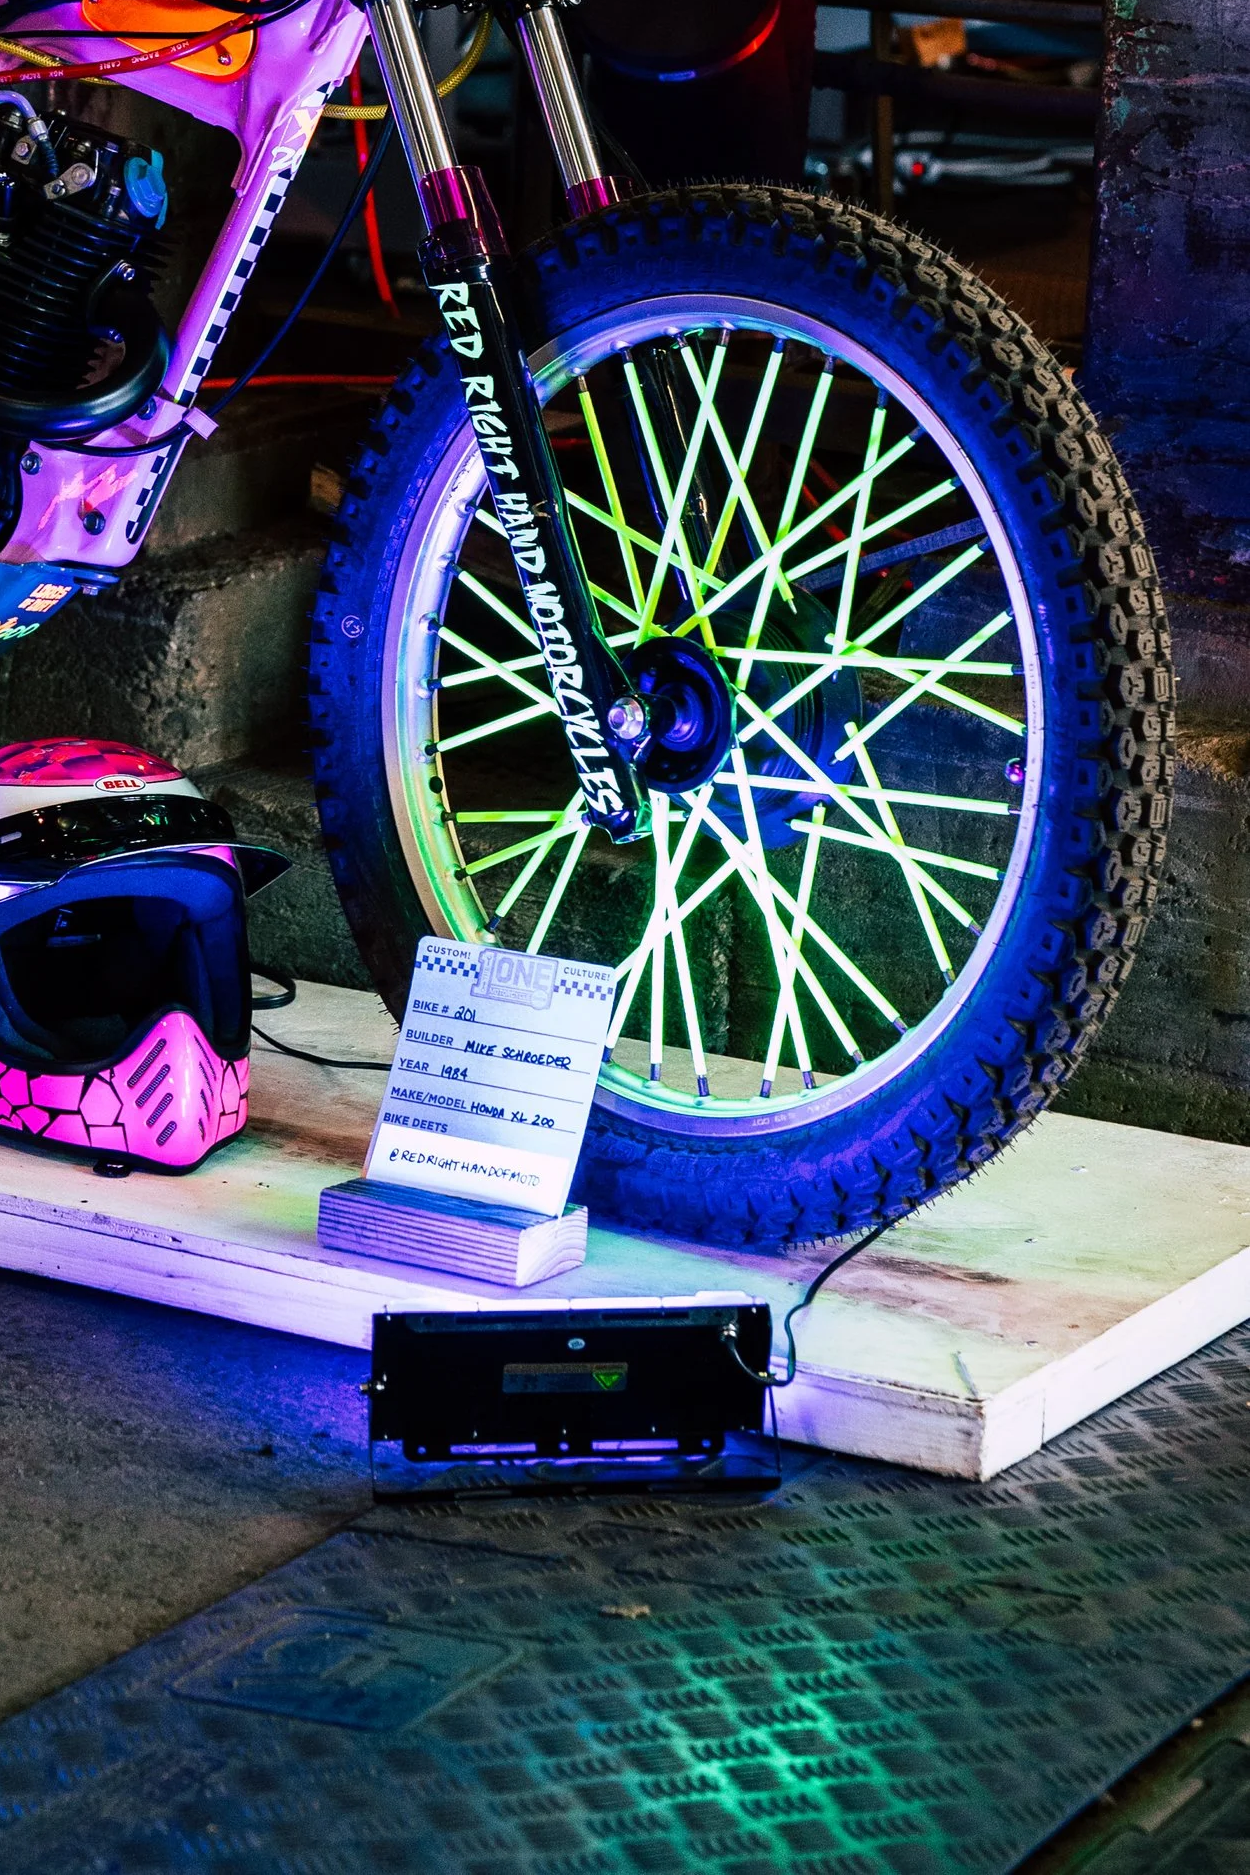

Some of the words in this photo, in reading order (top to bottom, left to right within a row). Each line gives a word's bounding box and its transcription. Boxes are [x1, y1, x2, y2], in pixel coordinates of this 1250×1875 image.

[430, 281, 484, 360] RED
[461, 373, 521, 482] RIGHT
[494, 492, 547, 576] HAND
[524, 581, 623, 816] MOTORCYCLES
[103, 777, 142, 791] BELL
[426, 944, 471, 960] CUSTOM!
[497, 957, 553, 992] ONE
[563, 966, 611, 982] CULTURE!
[413, 999, 439, 1014] BIKE
[454, 1005, 477, 1022] 201
[406, 1028, 455, 1047] BUILDER
[464, 1039, 497, 1057] MIKE
[501, 1046, 572, 1071] SCHROEDER
[400, 1058, 430, 1073] YEAR
[440, 1064, 468, 1081] 1984
[390, 1086, 468, 1111] MAKE/MODEL
[383, 1111, 409, 1127] BIKE
[411, 1117, 449, 1134] DEETS
[470, 1100, 505, 1119] HONDA
[510, 1110, 528, 1124] XL
[532, 1113, 555, 1129] 200
